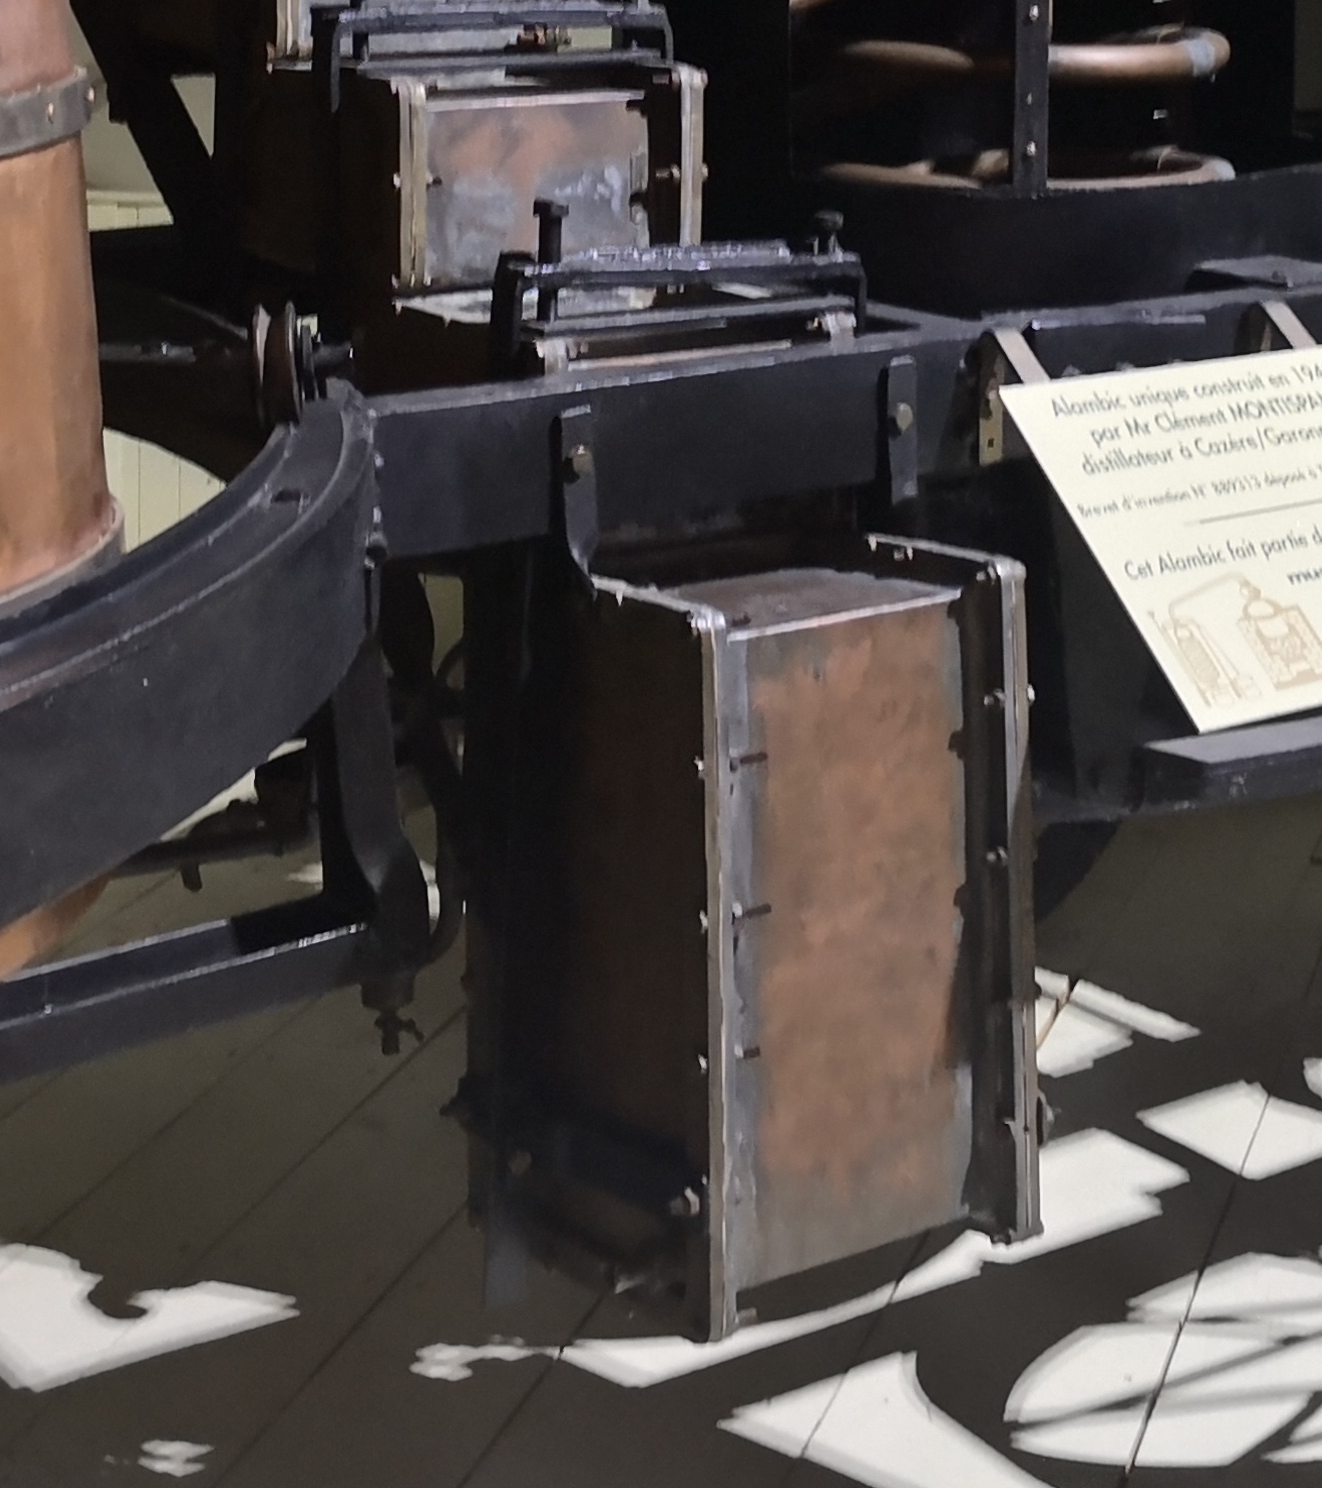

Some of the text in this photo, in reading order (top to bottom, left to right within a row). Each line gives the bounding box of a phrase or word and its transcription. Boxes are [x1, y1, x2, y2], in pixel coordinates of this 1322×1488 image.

[1051, 391, 1126, 417] Alambic
[1129, 386, 1190, 409] unique
[1193, 372, 1265, 399] construit
[1268, 374, 1290, 388] en
[1090, 426, 1121, 449] par
[1124, 417, 1151, 438] Mr
[1154, 407, 1228, 433] Clément
[1082, 448, 1174, 475] distillateur
[1179, 441, 1193, 460] à
[1124, 560, 1154, 580] Cet
[1158, 545, 1226, 574] Alambic
[1226, 538, 1257, 561] fait
[1260, 530, 1308, 561] partie
